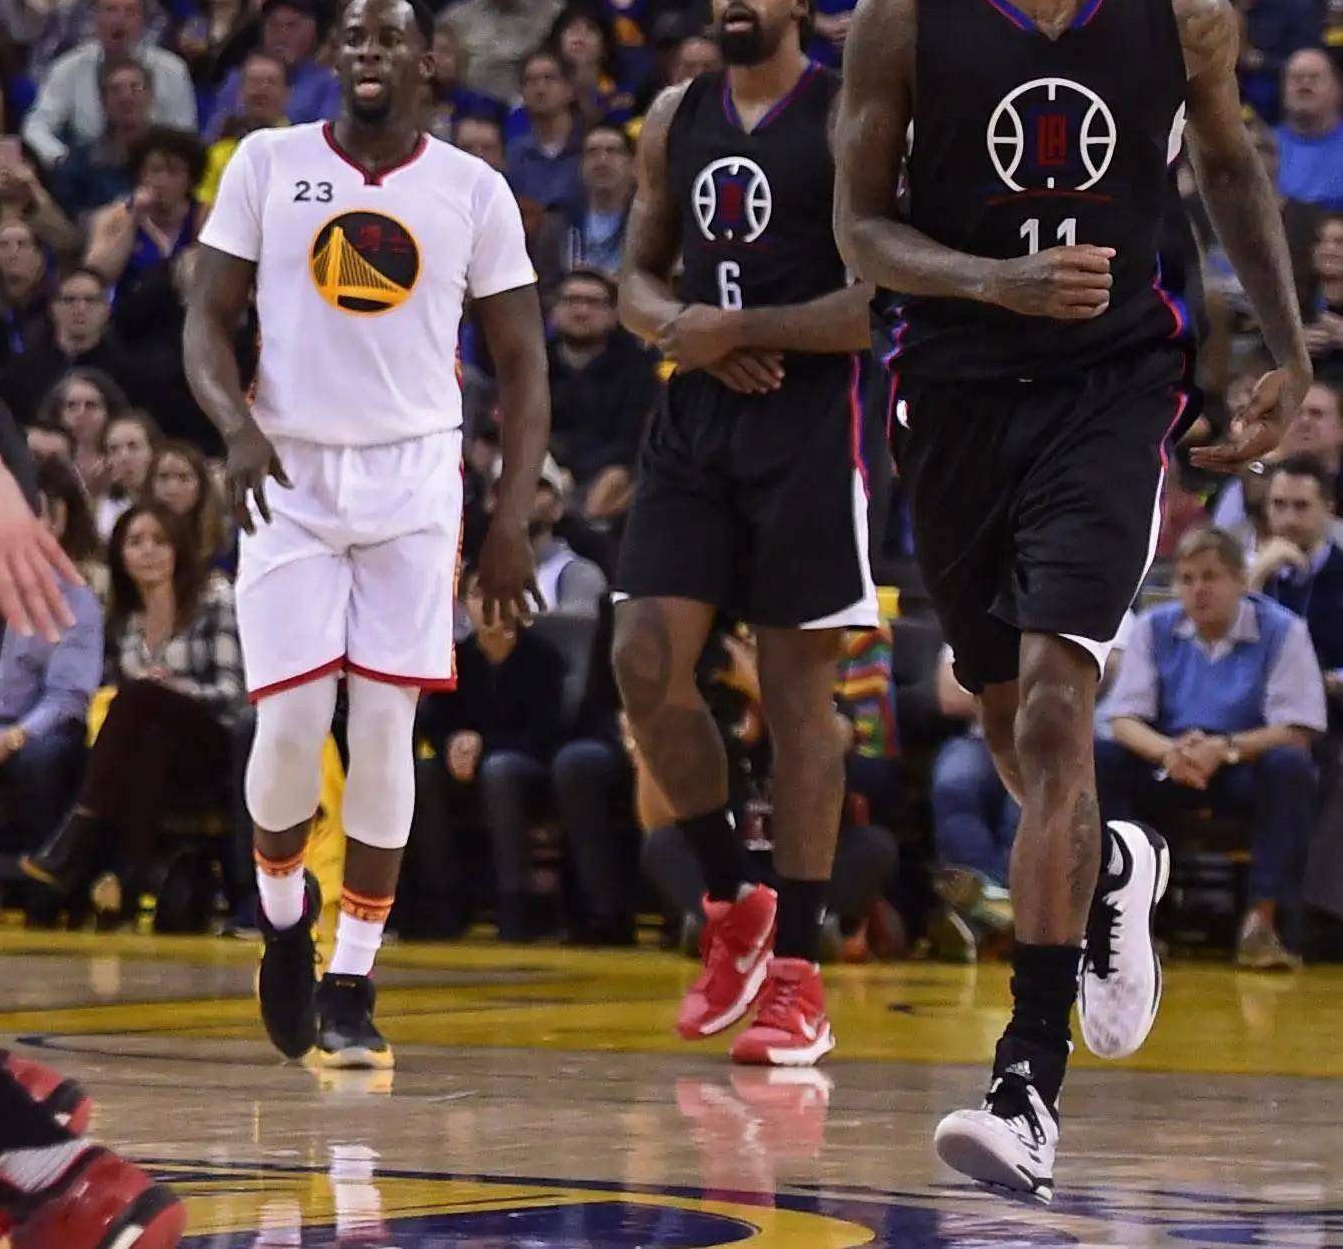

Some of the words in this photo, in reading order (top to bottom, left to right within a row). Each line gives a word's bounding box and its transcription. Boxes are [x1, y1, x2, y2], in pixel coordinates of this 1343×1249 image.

[293, 180, 334, 203] 23
[1020, 218, 1077, 255] 11
[718, 260, 743, 312] 6
